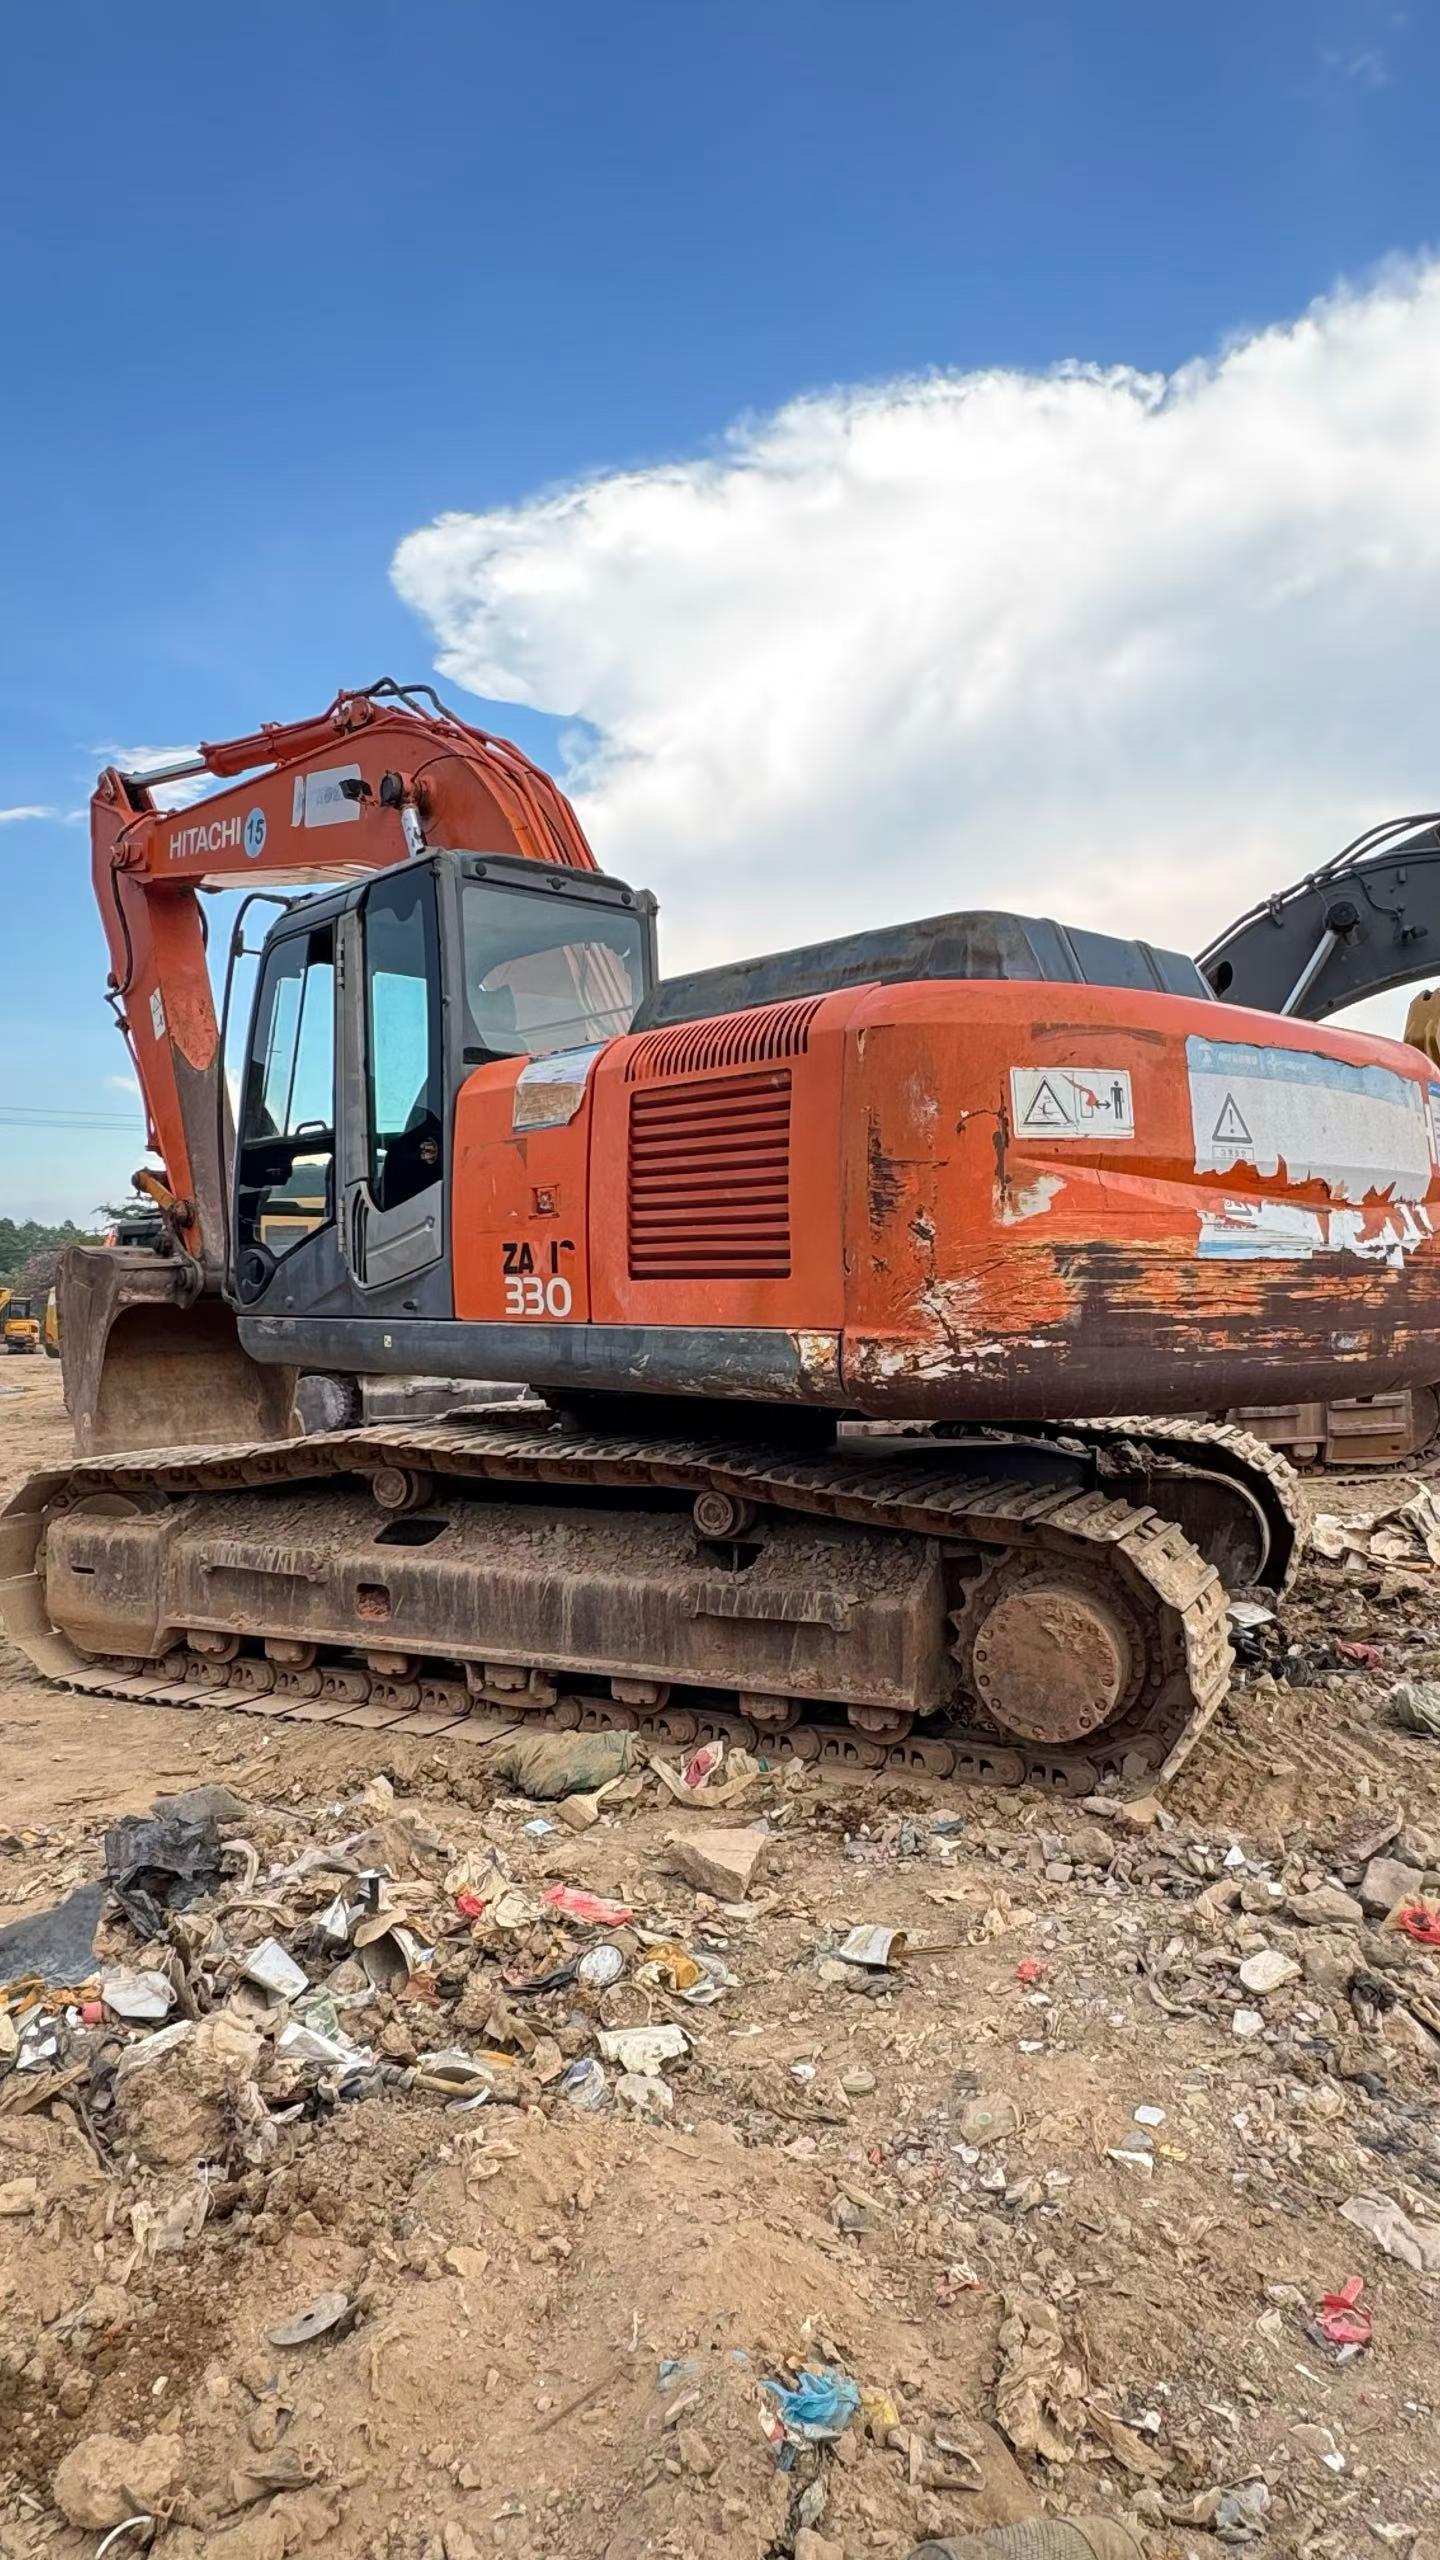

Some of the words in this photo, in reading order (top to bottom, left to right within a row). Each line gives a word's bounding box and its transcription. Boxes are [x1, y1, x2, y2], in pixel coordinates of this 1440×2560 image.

[169, 816, 241, 860] HITACHI
[247, 818, 264, 845] 15
[502, 1240, 575, 1274] ZAI
[504, 1276, 572, 1317] 330
